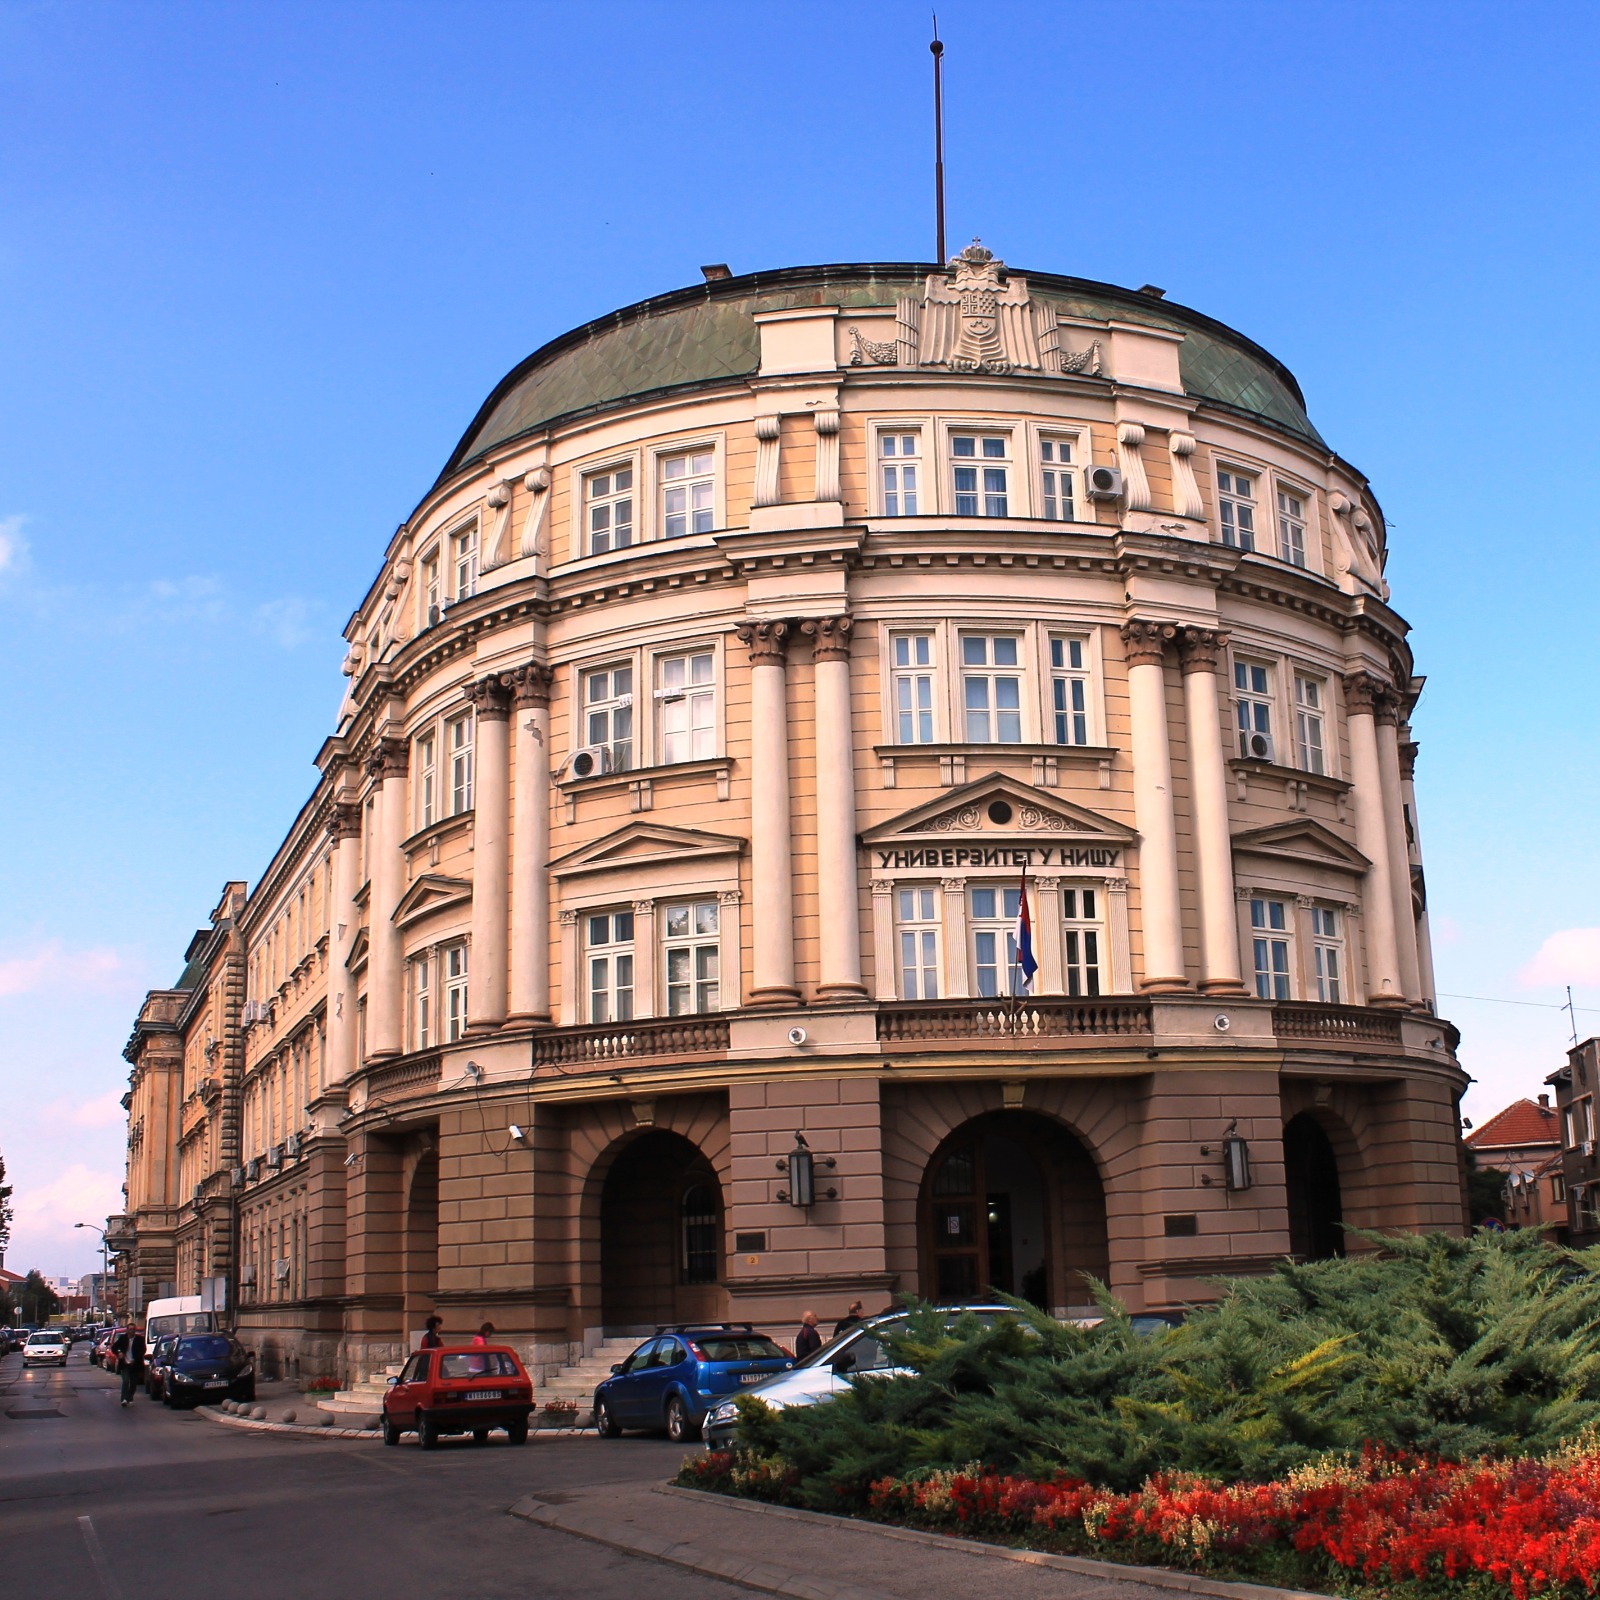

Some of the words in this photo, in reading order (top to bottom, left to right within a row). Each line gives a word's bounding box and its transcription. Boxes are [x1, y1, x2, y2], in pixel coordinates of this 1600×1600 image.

[878, 848, 1035, 868] УНИВЕРЗИТЕТ
[1038, 848, 1053, 865] У
[1061, 849, 1120, 867] НИШУ
